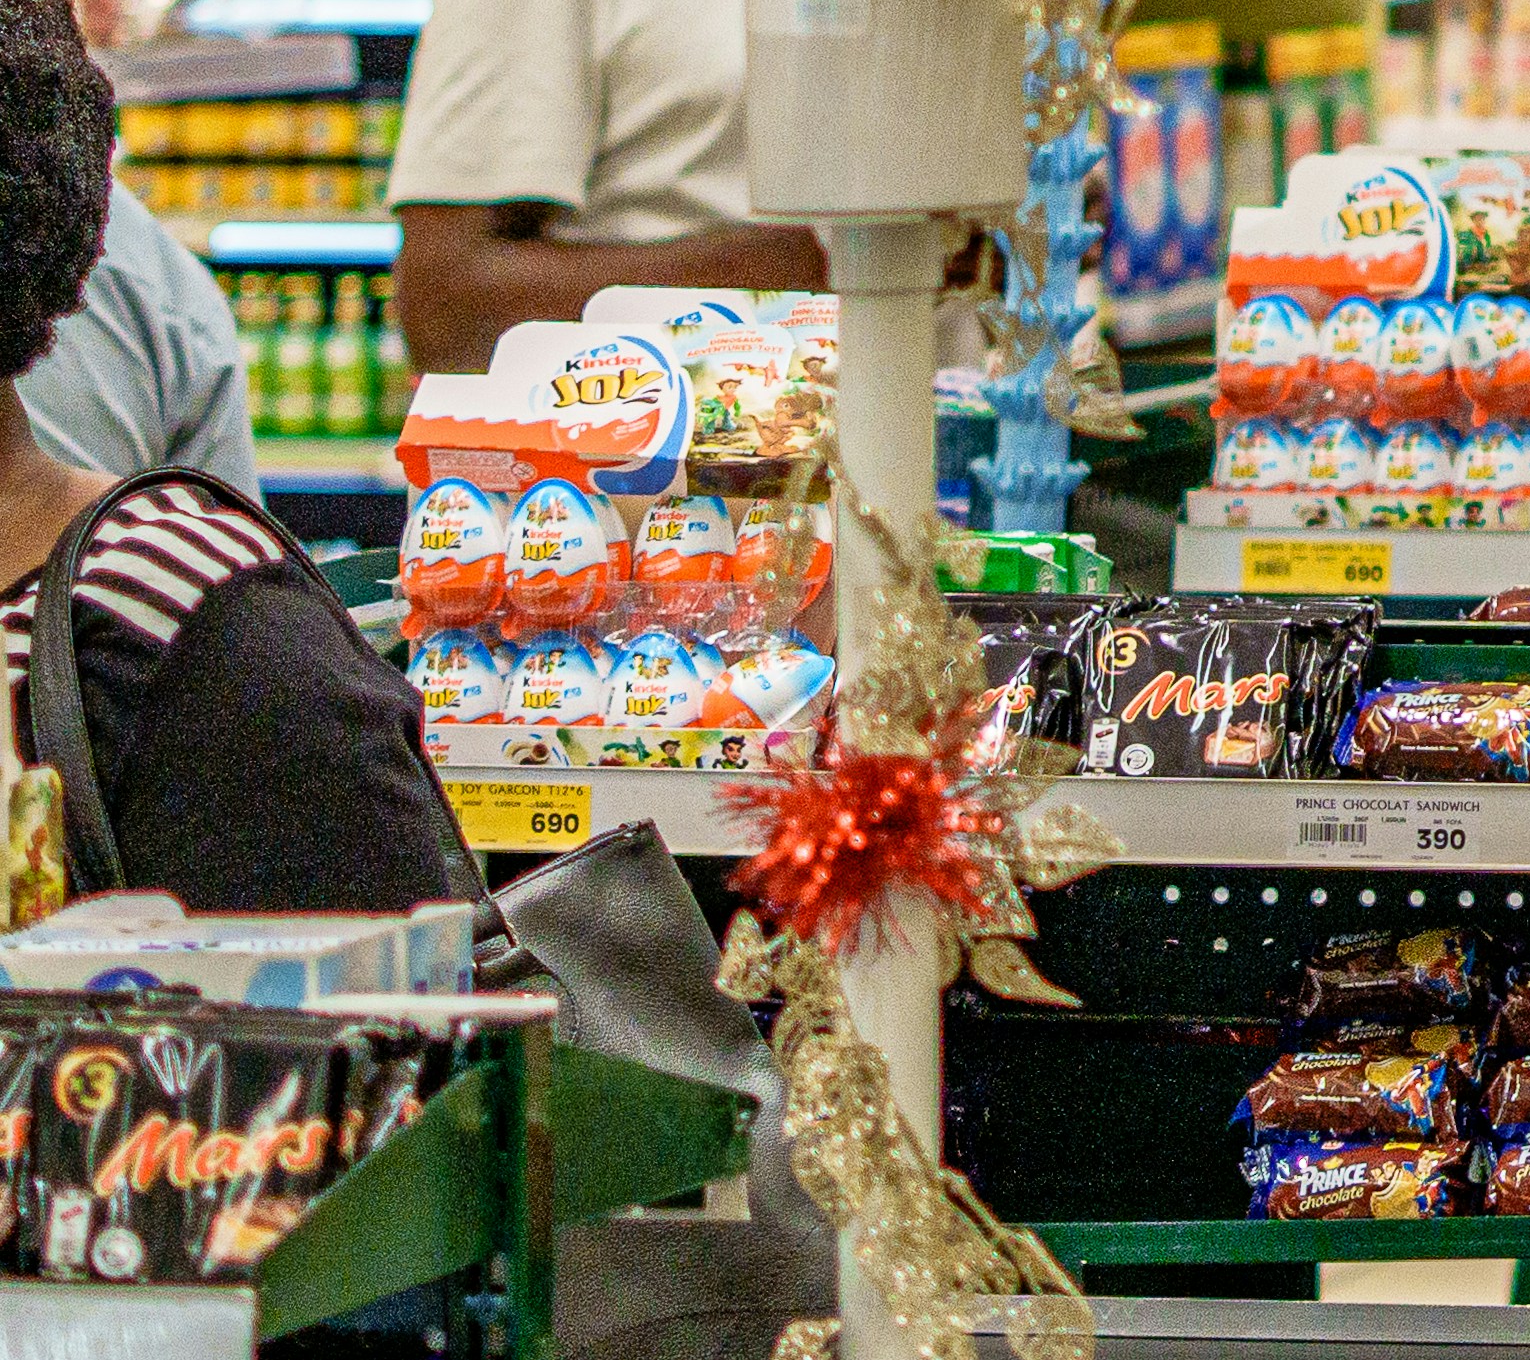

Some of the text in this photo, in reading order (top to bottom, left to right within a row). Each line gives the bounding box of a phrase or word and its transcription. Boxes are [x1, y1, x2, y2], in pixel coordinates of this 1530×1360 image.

[565, 355, 645, 373] Kinder
[551, 368, 665, 408] JOY
[421, 516, 464, 528] Kinder
[420, 529, 462, 550] JOY
[522, 528, 563, 540] Kinder
[521, 541, 562, 562] JOY
[1343, 565, 1384, 583] 690
[625, 680, 669, 695] Kinder
[1121, 670, 1290, 724] Mars
[521, 688, 562, 710] JOY
[624, 695, 666, 717] JOY
[1394, 691, 1464, 709] PRINCE
[488, 783, 541, 795] GARCON
[1295, 797, 1481, 812] PRINCE CHOCOLAT SANDWICH
[530, 812, 580, 834] 690
[1416, 828, 1467, 850] 390
[1291, 1057, 1362, 1072] chocolate
[94, 1111, 331, 1197] Mars
[1298, 1162, 1368, 1197] PRINCE
[1299, 1185, 1365, 1212] chocolate
